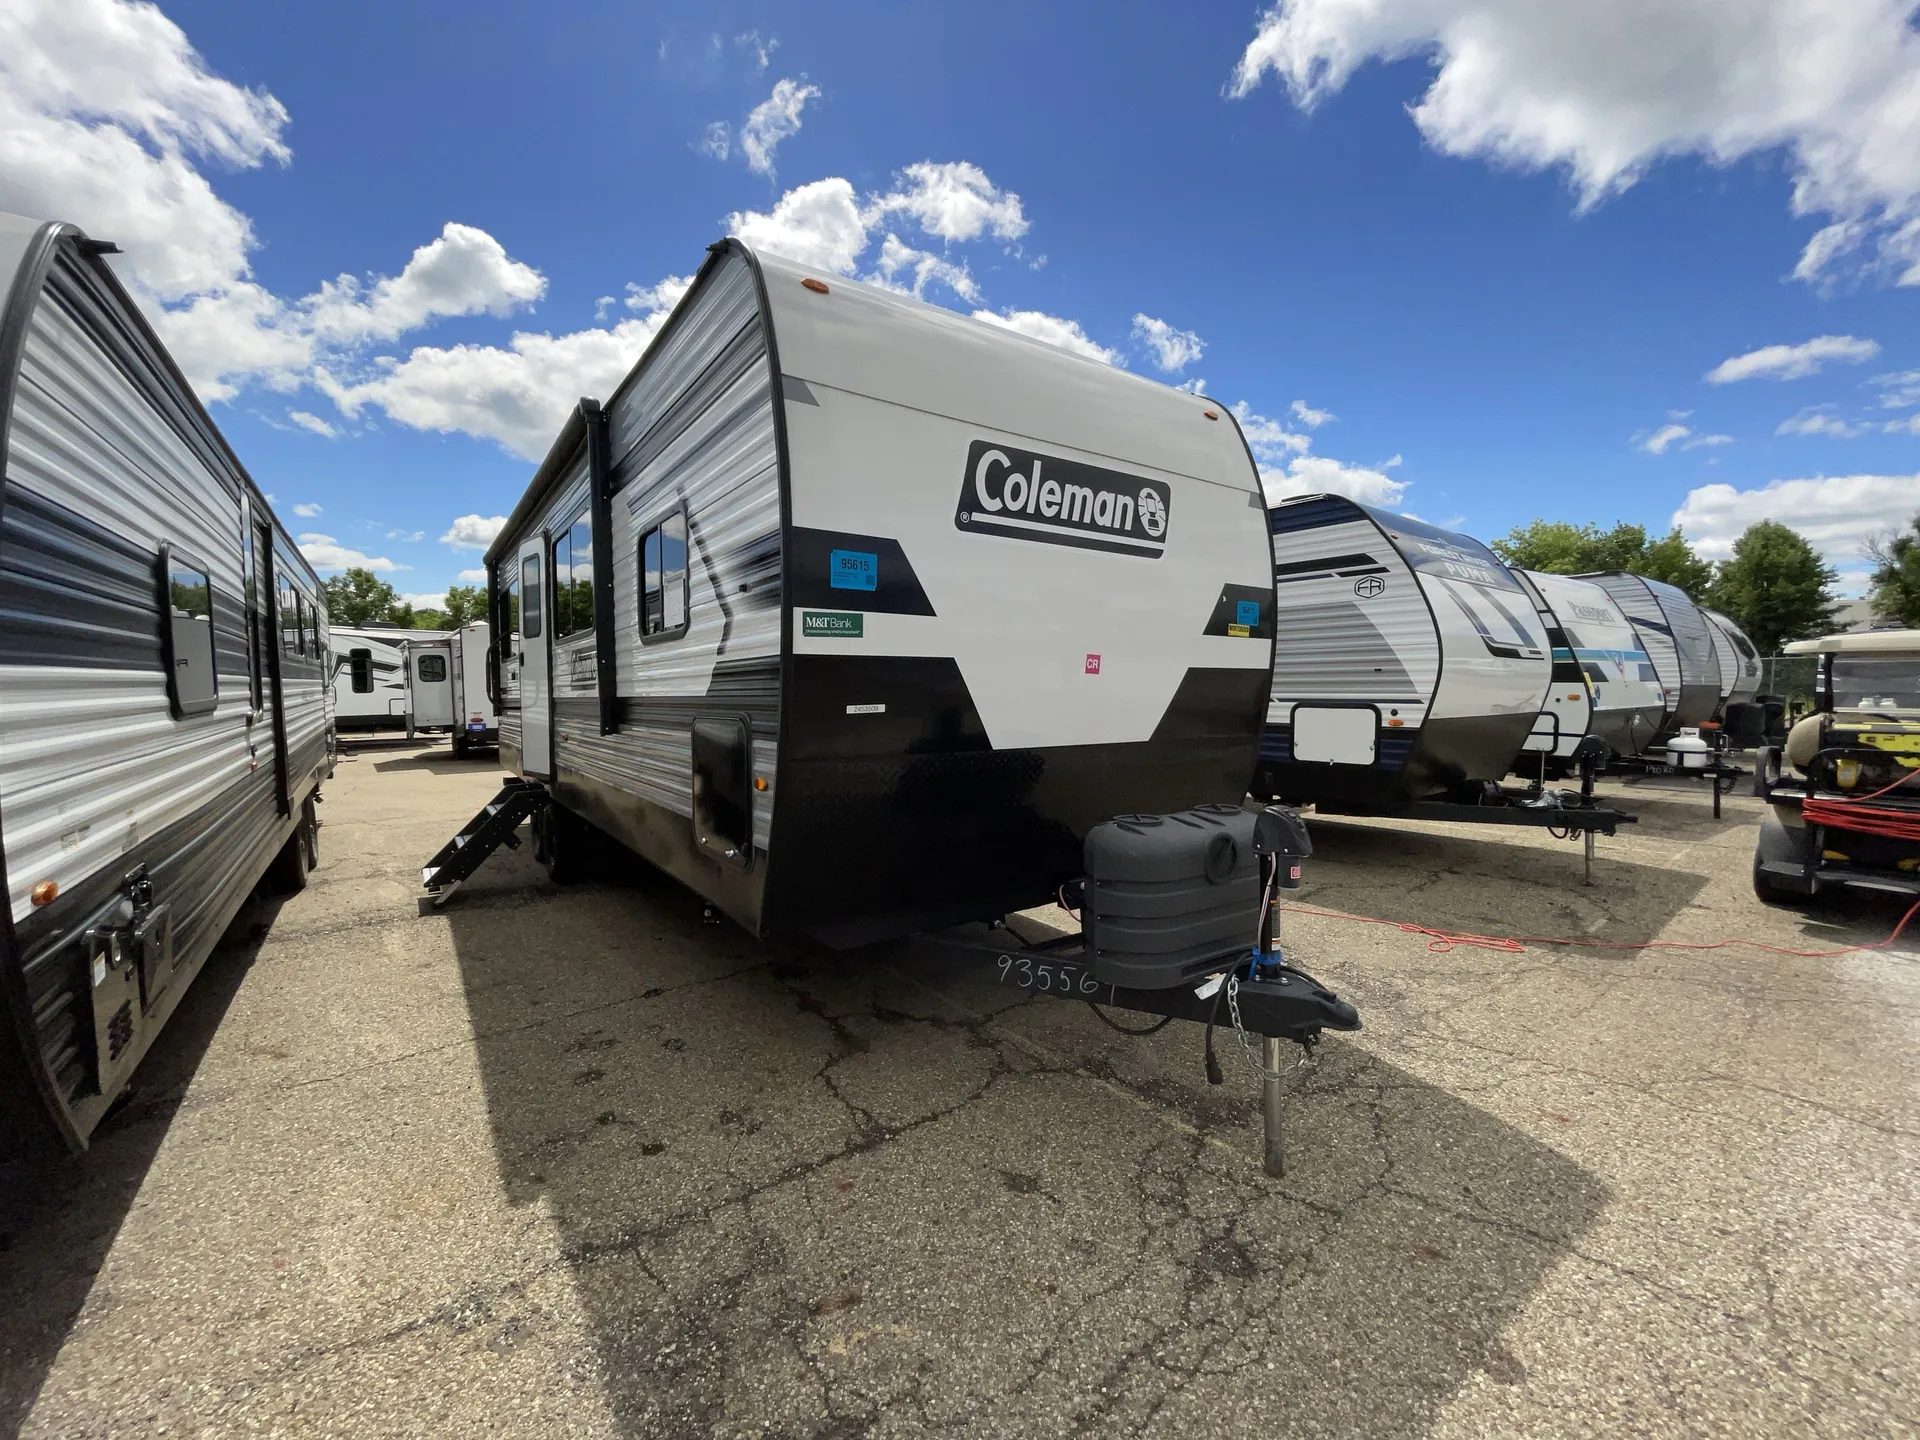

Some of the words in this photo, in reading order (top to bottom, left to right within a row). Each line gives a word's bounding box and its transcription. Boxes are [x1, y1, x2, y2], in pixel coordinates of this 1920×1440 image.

[975, 449, 1135, 531] Coleman
[1417, 543, 1462, 561] FOREST
[841, 558, 869, 571] 95615
[1444, 562, 1495, 584] PUMA
[1566, 601, 1616, 622] Passport
[806, 616, 830, 628] M&T
[830, 617, 852, 628] Bank
[1086, 658, 1099, 669] CR
[997, 954, 1099, 994] 93556
